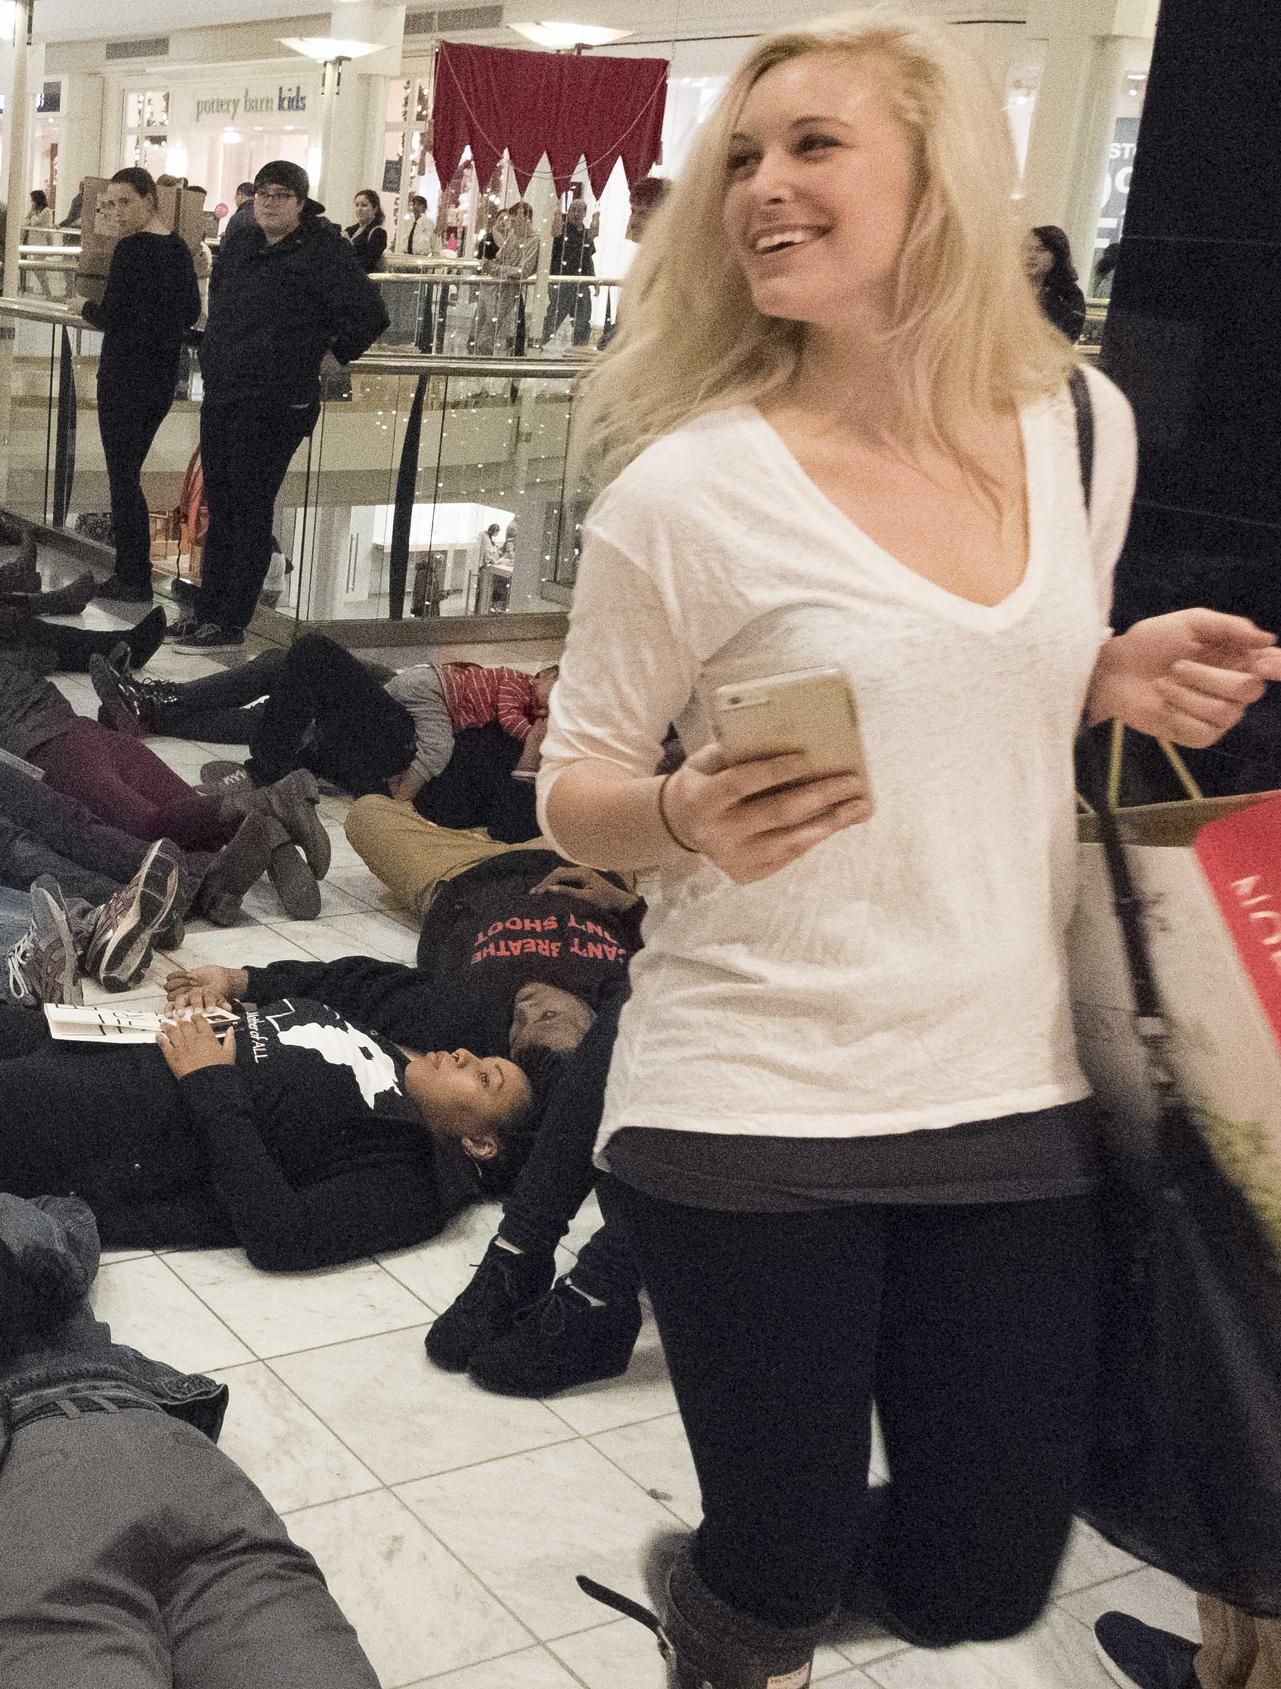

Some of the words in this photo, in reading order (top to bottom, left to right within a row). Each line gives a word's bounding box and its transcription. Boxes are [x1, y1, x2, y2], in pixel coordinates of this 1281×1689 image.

[195, 97, 240, 122] pottery
[243, 88, 274, 113] barn
[278, 86, 306, 112] kids
[474, 915, 560, 947] SHOOT
[471, 938, 562, 965] BREATHE
[250, 1030, 269, 1041] of
[252, 1040, 269, 1064] ALL
